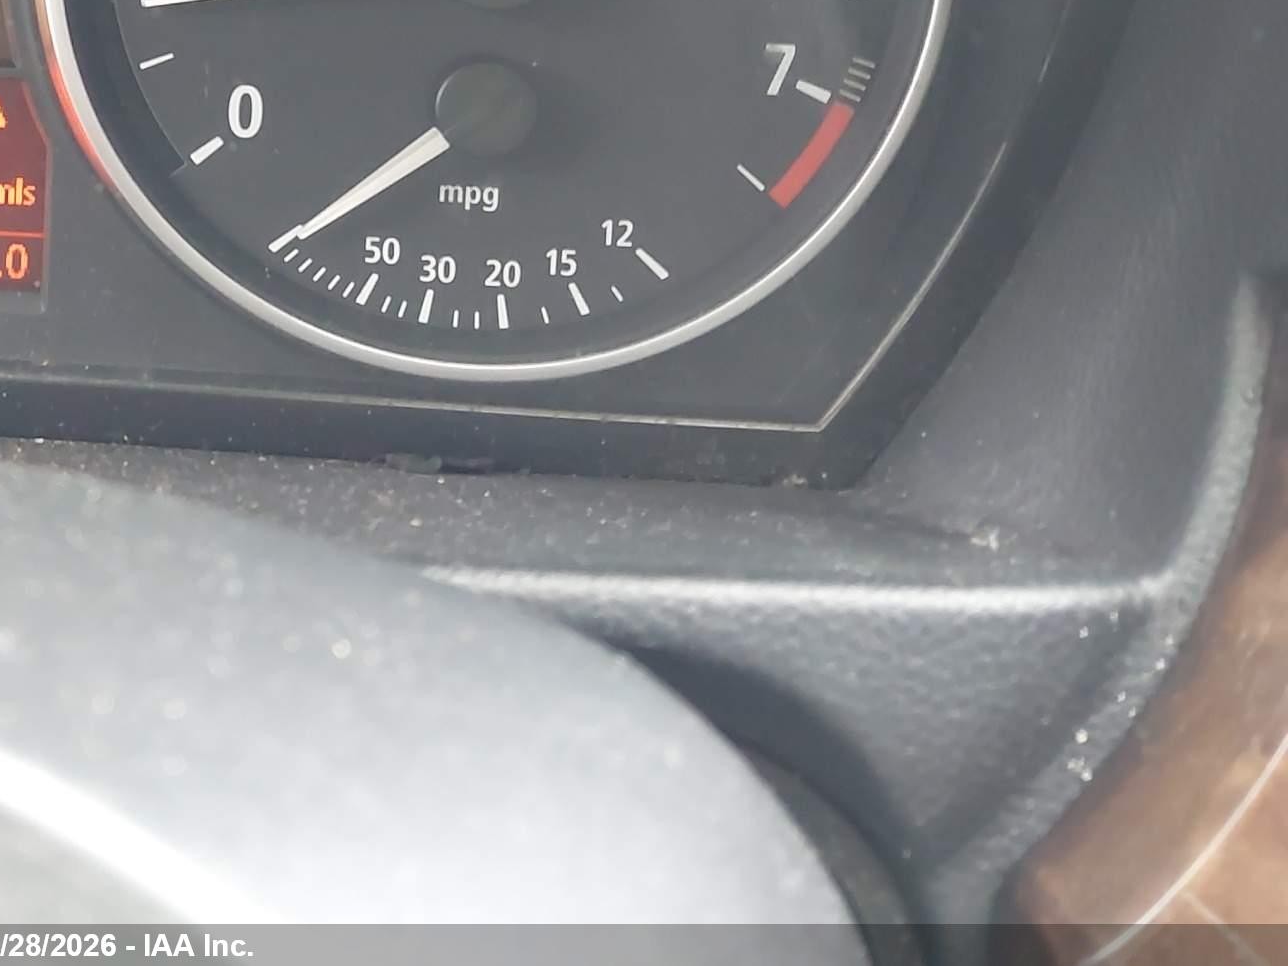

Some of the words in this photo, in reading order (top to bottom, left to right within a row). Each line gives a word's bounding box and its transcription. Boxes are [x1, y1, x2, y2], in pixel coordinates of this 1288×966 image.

[766, 43, 797, 96] 7
[227, 84, 263, 139] 0
[438, 181, 499, 211] mpg
[601, 219, 633, 248] 12
[364, 236, 400, 266] 50
[545, 249, 577, 277] 15
[419, 254, 456, 284] 30
[484, 259, 521, 289] 20
